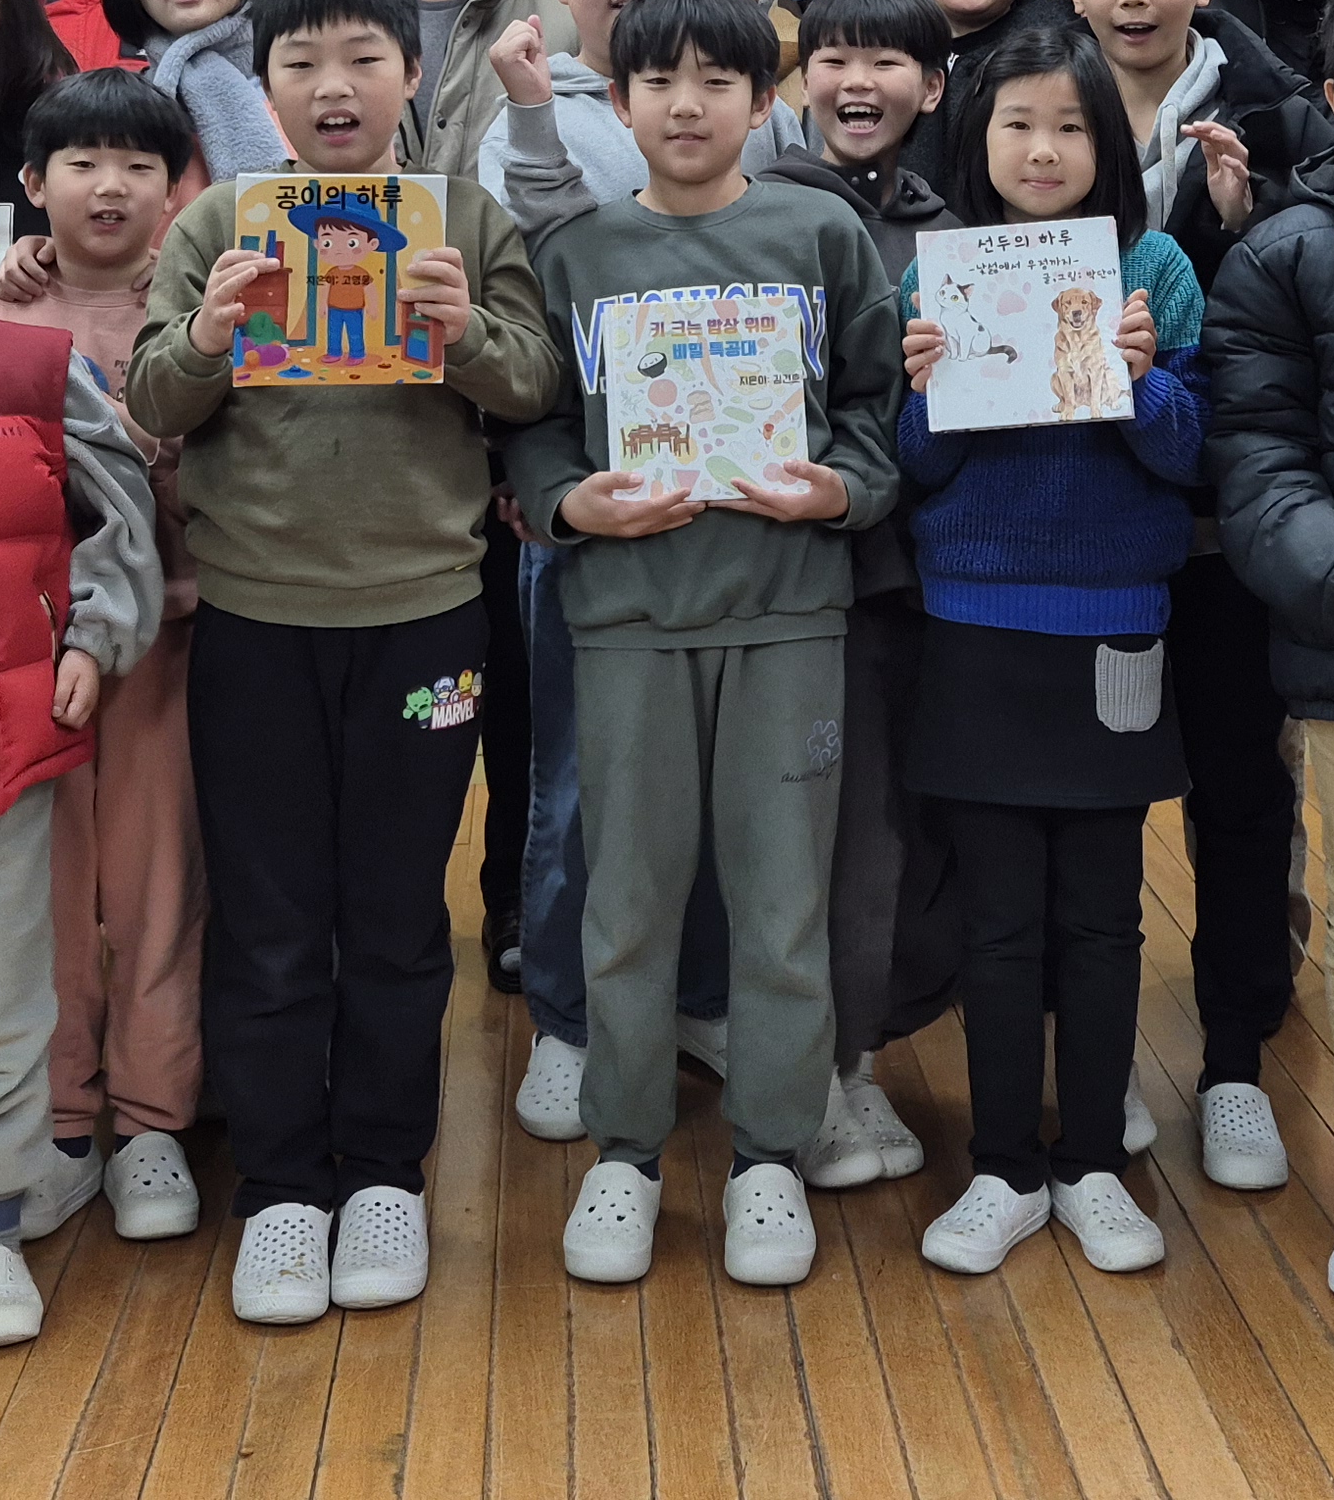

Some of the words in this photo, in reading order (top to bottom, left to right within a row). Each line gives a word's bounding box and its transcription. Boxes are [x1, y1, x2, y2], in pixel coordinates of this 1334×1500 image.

[276, 184, 346, 210] 공이의
[356, 184, 403, 210] 하루
[978, 234, 1030, 253] 선두의
[1038, 229, 1073, 247] 하루
[650, 321, 665, 337] 키
[671, 320, 703, 336] 크는
[707, 318, 739, 335] 밥상
[744, 316, 776, 333] 위의
[672, 342, 703, 360] 비밀
[709, 340, 757, 358] 특공대
[431, 696, 475, 730] MARVEL
